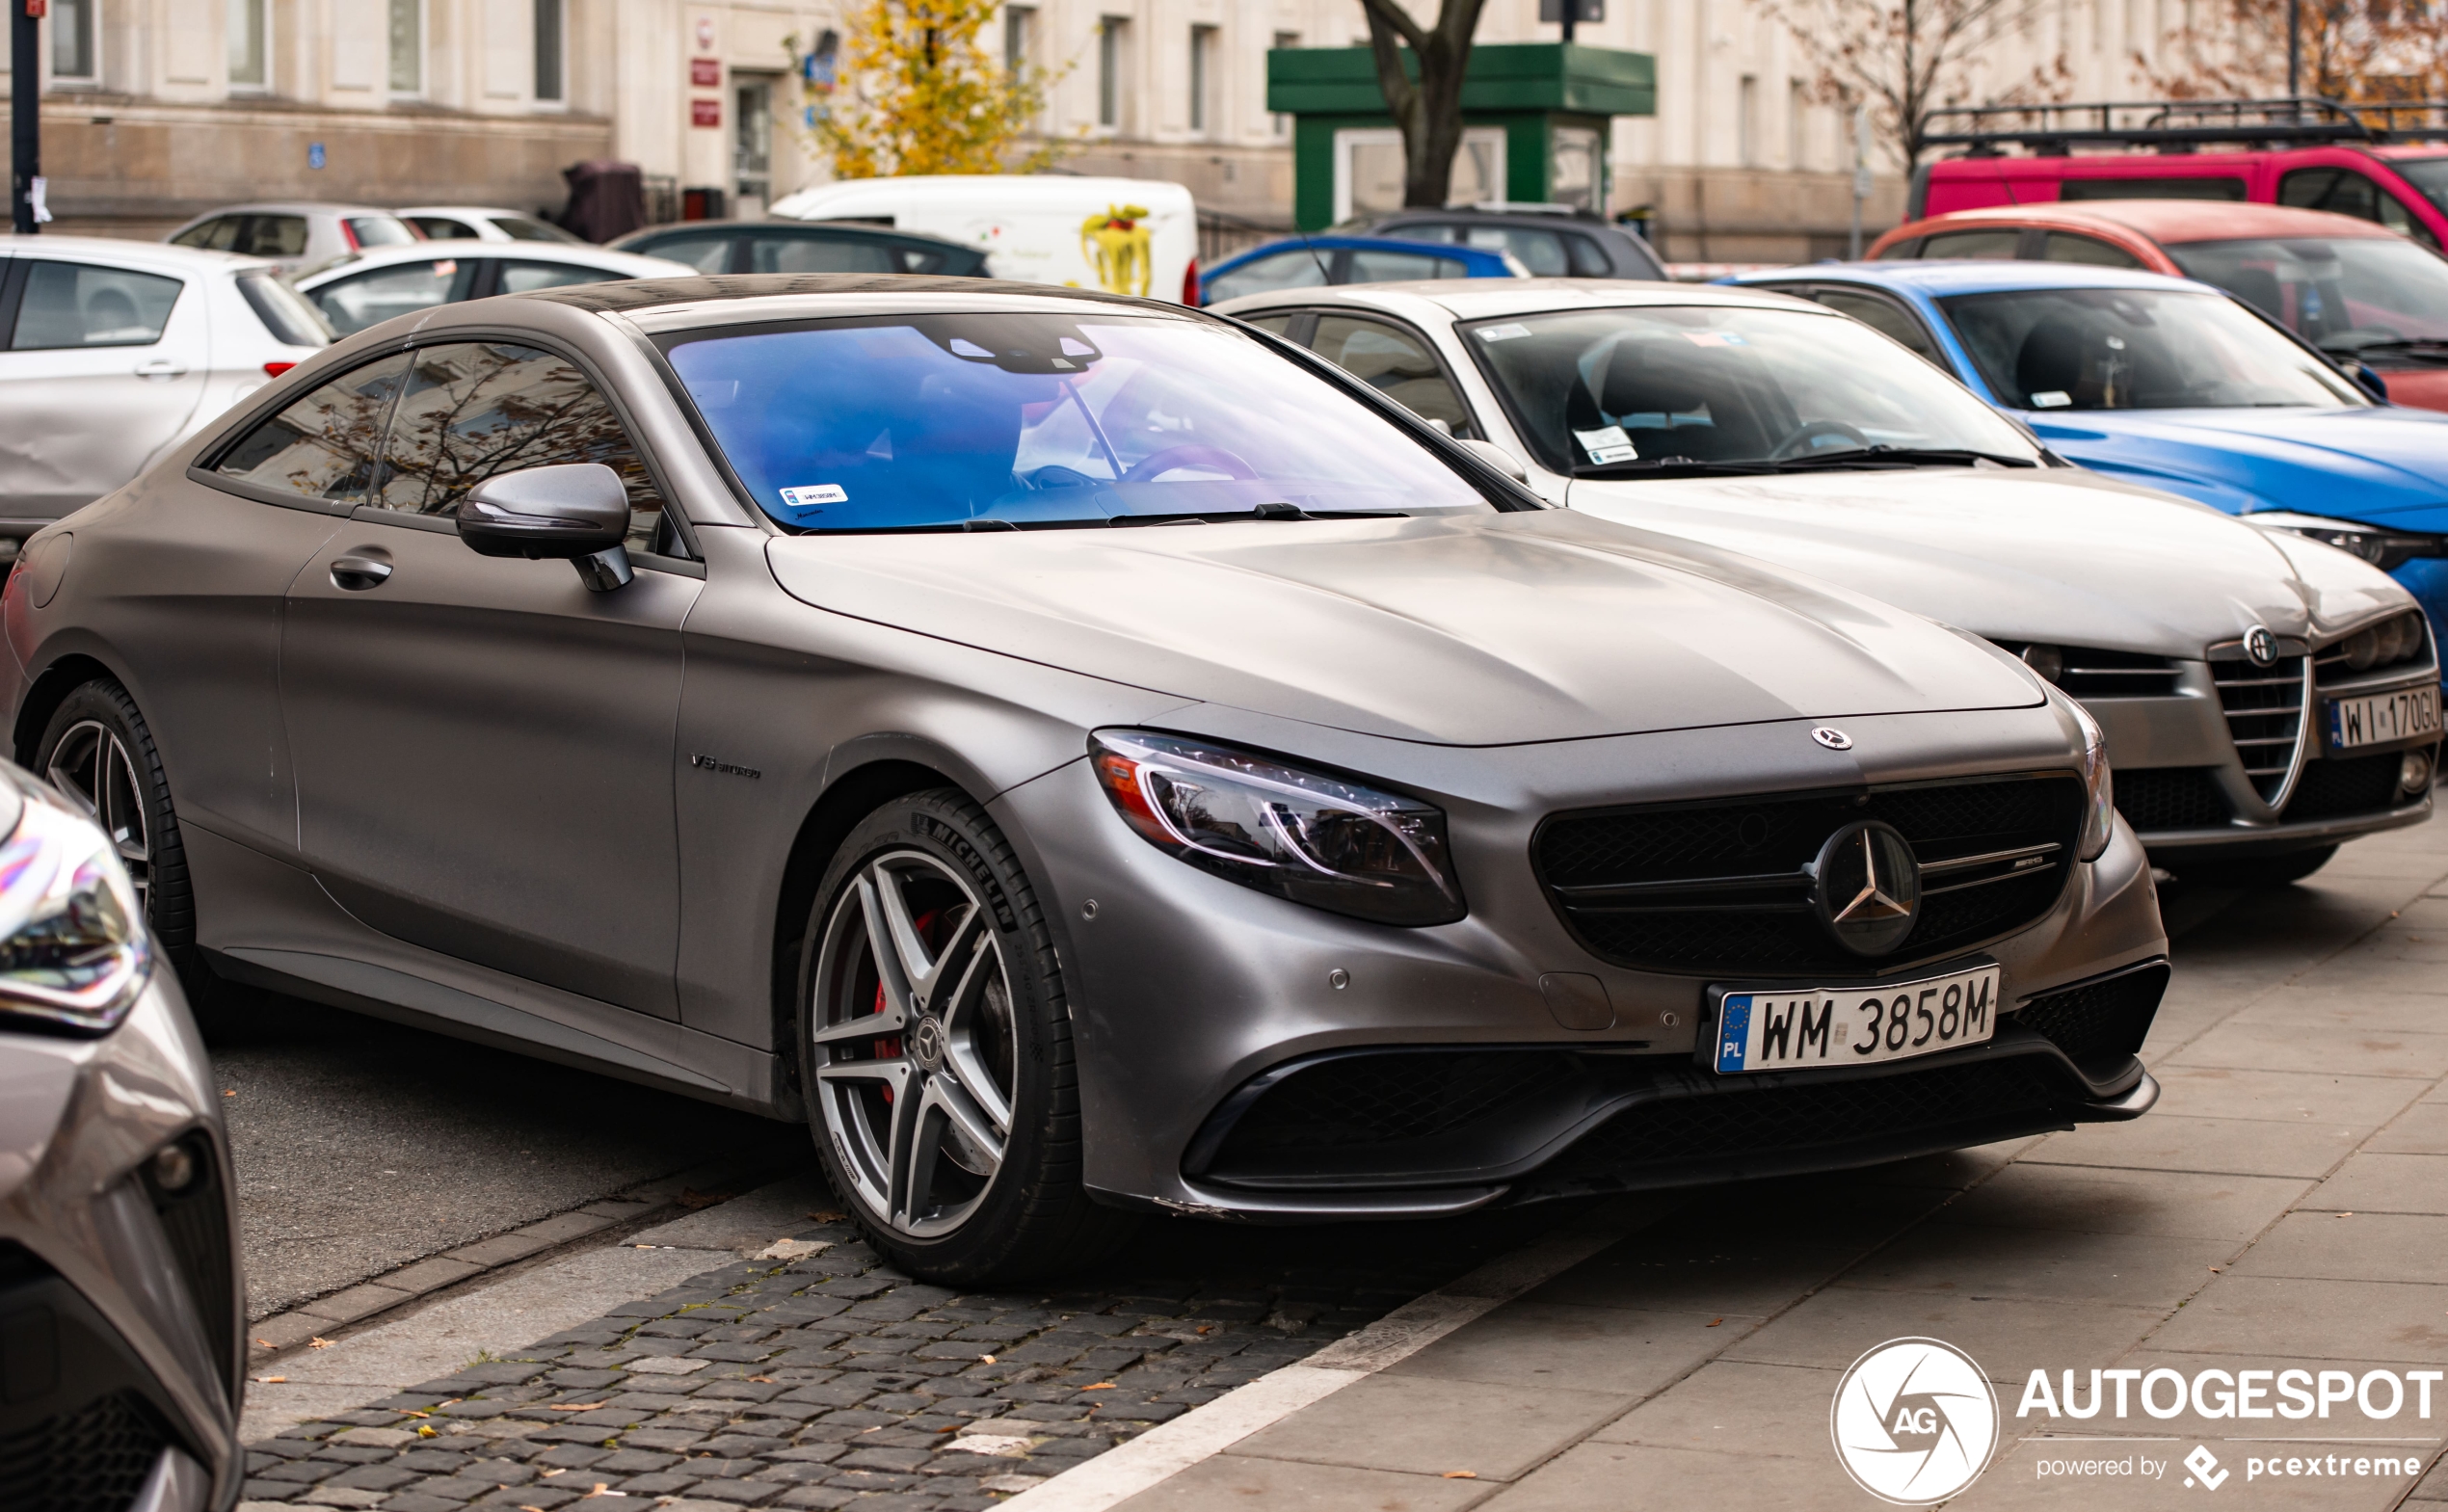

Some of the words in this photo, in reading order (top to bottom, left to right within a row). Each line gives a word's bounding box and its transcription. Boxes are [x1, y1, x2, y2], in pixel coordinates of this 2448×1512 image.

[2345, 700, 2375, 745] WI
[2389, 689, 2440, 737] 170GU
[932, 823, 1015, 925] MICHELIN
[1723, 1042, 1743, 1058] PL
[1761, 999, 1834, 1061] WM
[1852, 975, 1990, 1055] 3858M
